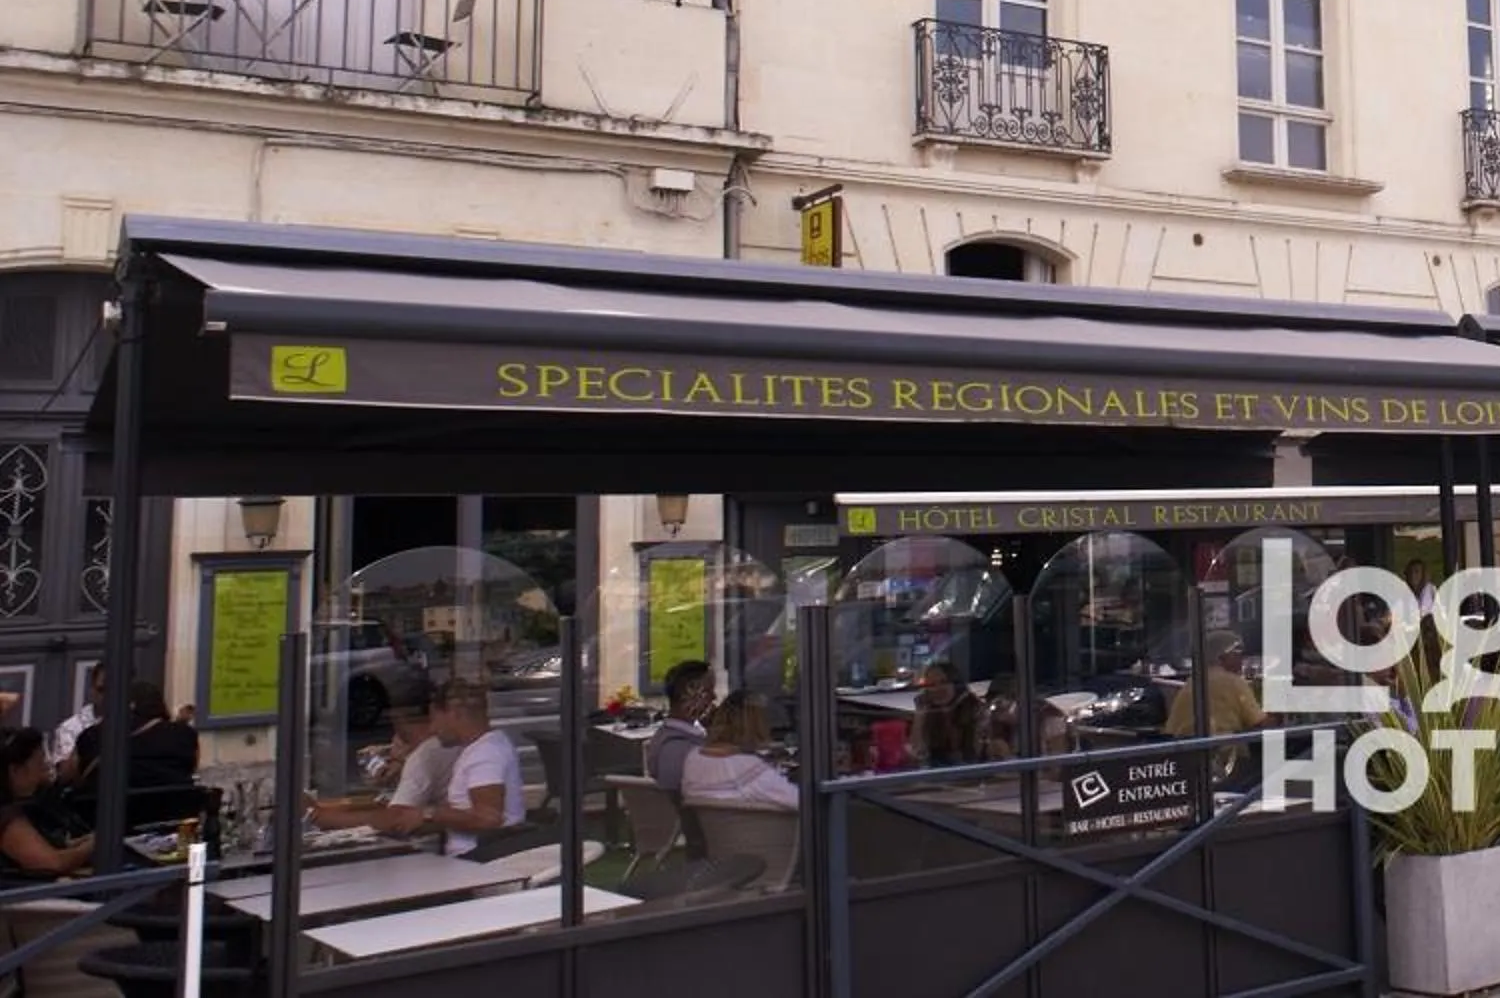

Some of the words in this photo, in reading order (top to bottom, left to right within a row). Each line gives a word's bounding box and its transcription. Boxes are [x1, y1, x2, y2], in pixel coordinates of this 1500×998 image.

[497, 362, 873, 409] SPECIALITES
[893, 379, 1199, 419] REGIONALES
[1215, 392, 1258, 420] ET
[1272, 394, 1371, 423] VINS
[1380, 398, 1428, 425] DE
[901, 505, 997, 531] HÔTEL
[1016, 506, 1137, 528] CRISTAL
[1153, 501, 1323, 525] RESTAURANT
[1128, 758, 1178, 781] ENTRÉE
[1117, 780, 1189, 803] ENTRANCE
[1069, 820, 1089, 834] BAR
[1133, 804, 1191, 824] RESTAURANT
